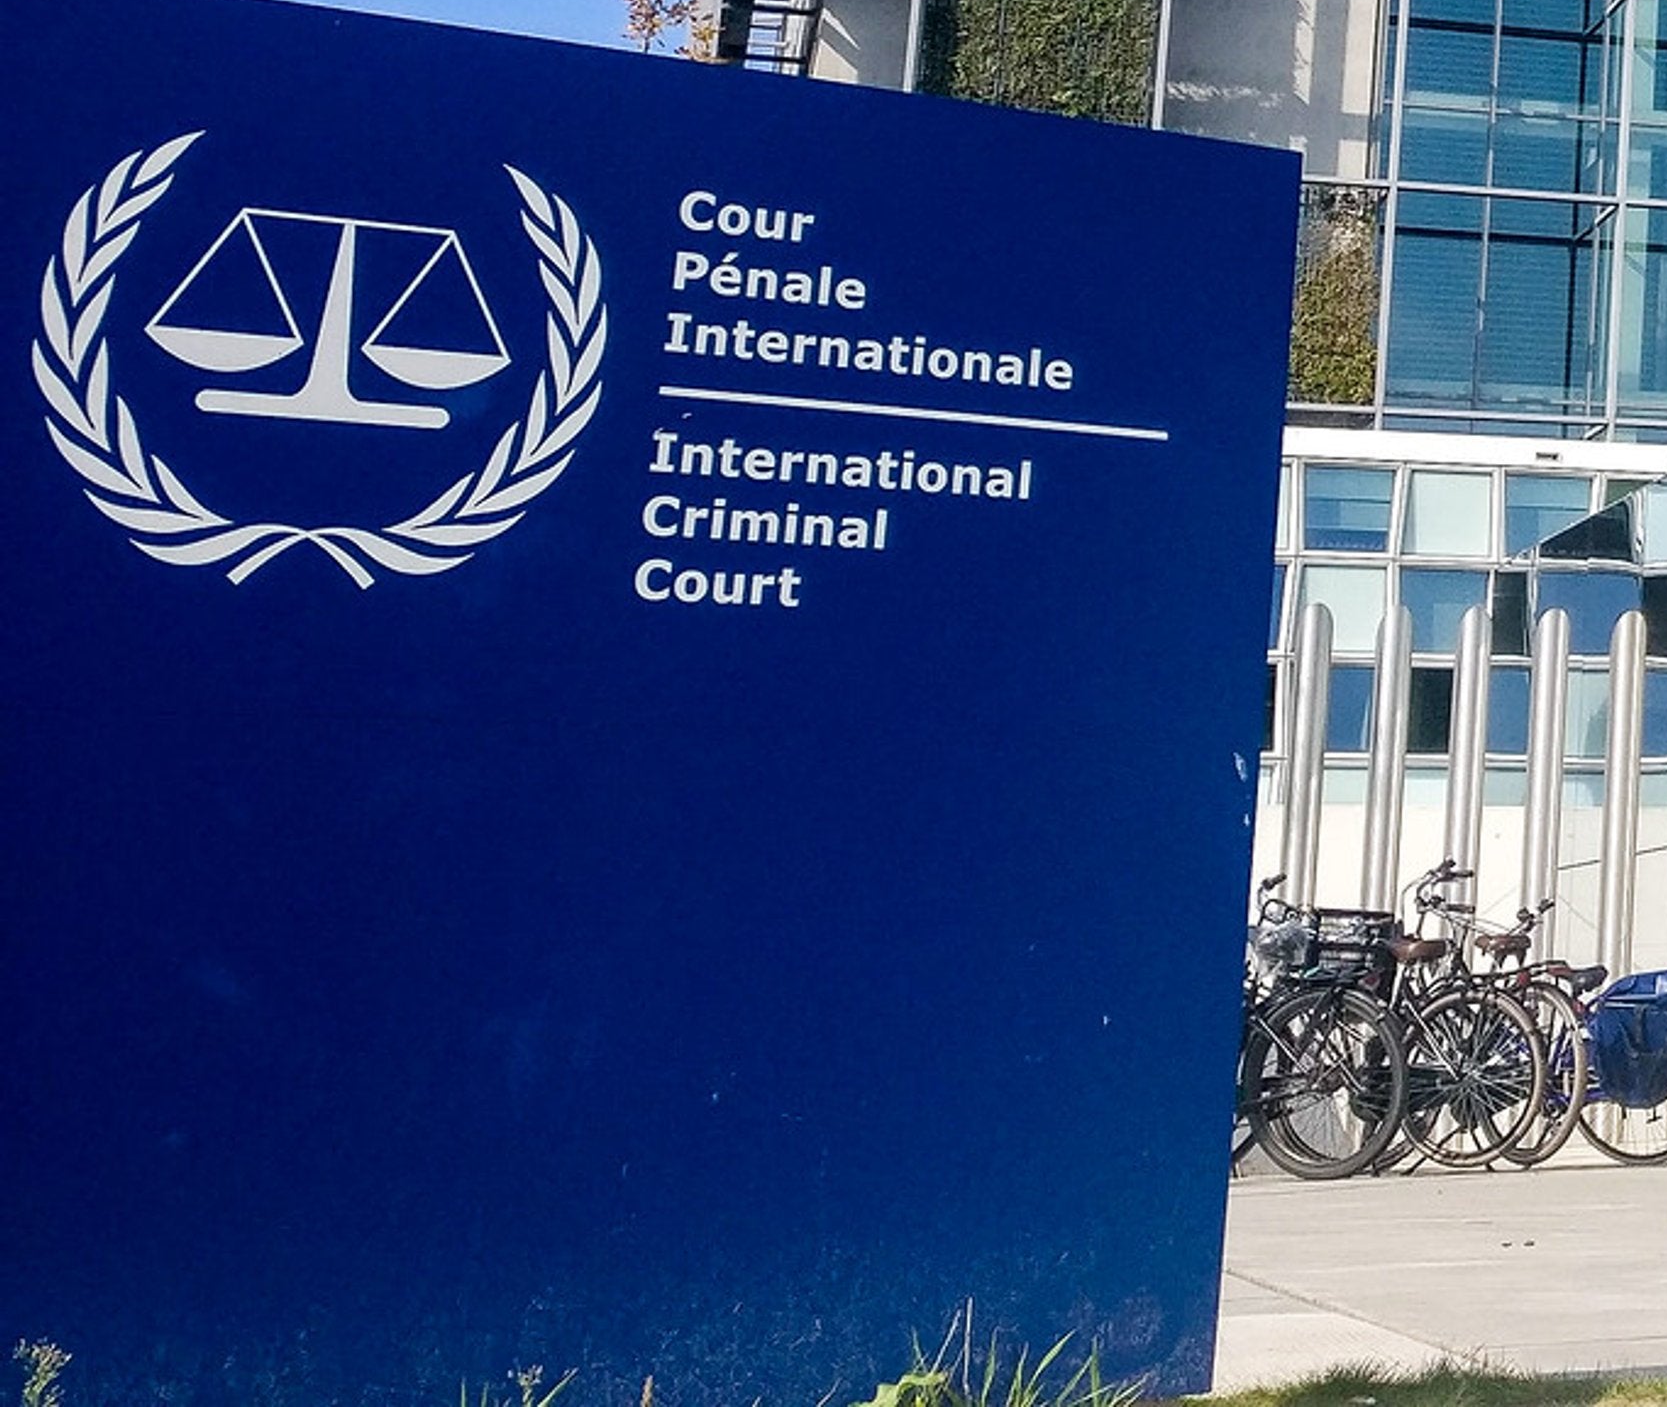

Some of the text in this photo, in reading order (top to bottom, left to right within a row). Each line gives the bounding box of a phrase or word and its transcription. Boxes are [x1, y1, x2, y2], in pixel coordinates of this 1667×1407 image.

[680, 191, 814, 241] Cour
[674, 252, 865, 308] Pénale
[664, 313, 1072, 389] Internationale
[650, 432, 1031, 499] International
[643, 496, 887, 549] Criminal
[635, 559, 801, 606] Court
